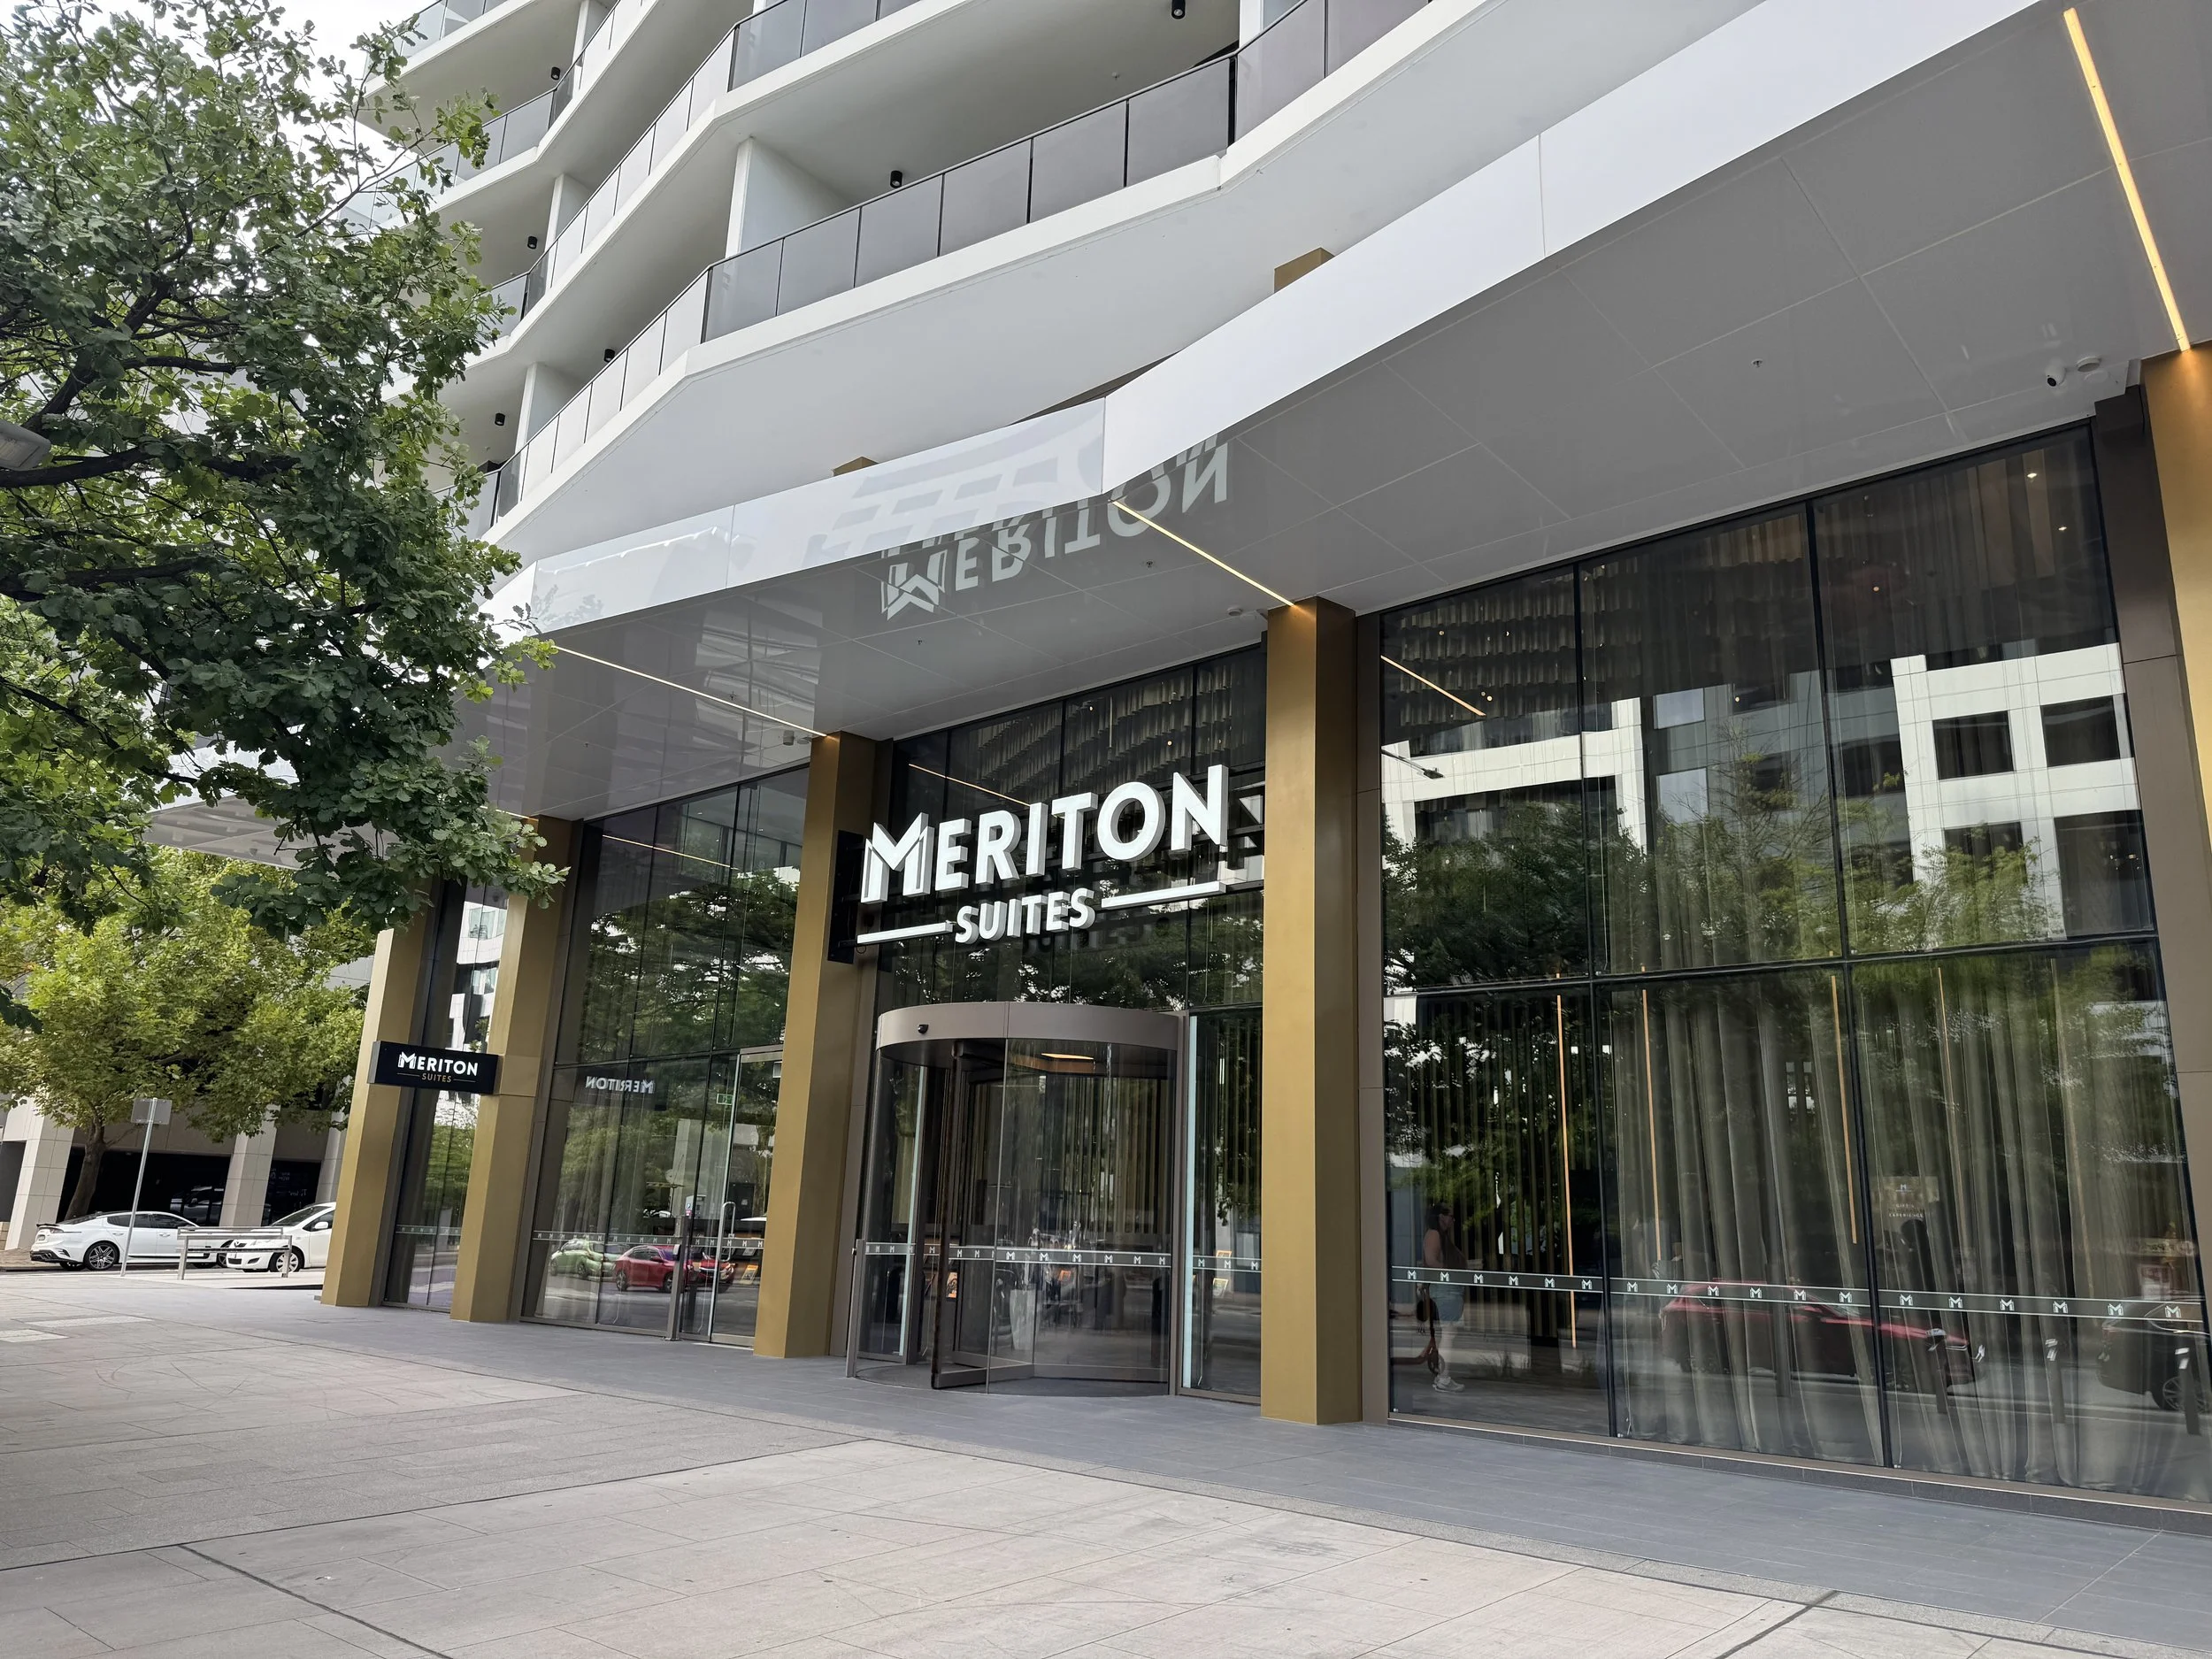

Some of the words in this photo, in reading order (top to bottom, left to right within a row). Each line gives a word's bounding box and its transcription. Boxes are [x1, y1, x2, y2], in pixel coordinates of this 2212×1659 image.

[861, 764, 1228, 903] MERITON
[956, 888, 1096, 944] SUITES
[397, 1051, 478, 1076] MERITON
[421, 1072, 452, 1083] SUITES
